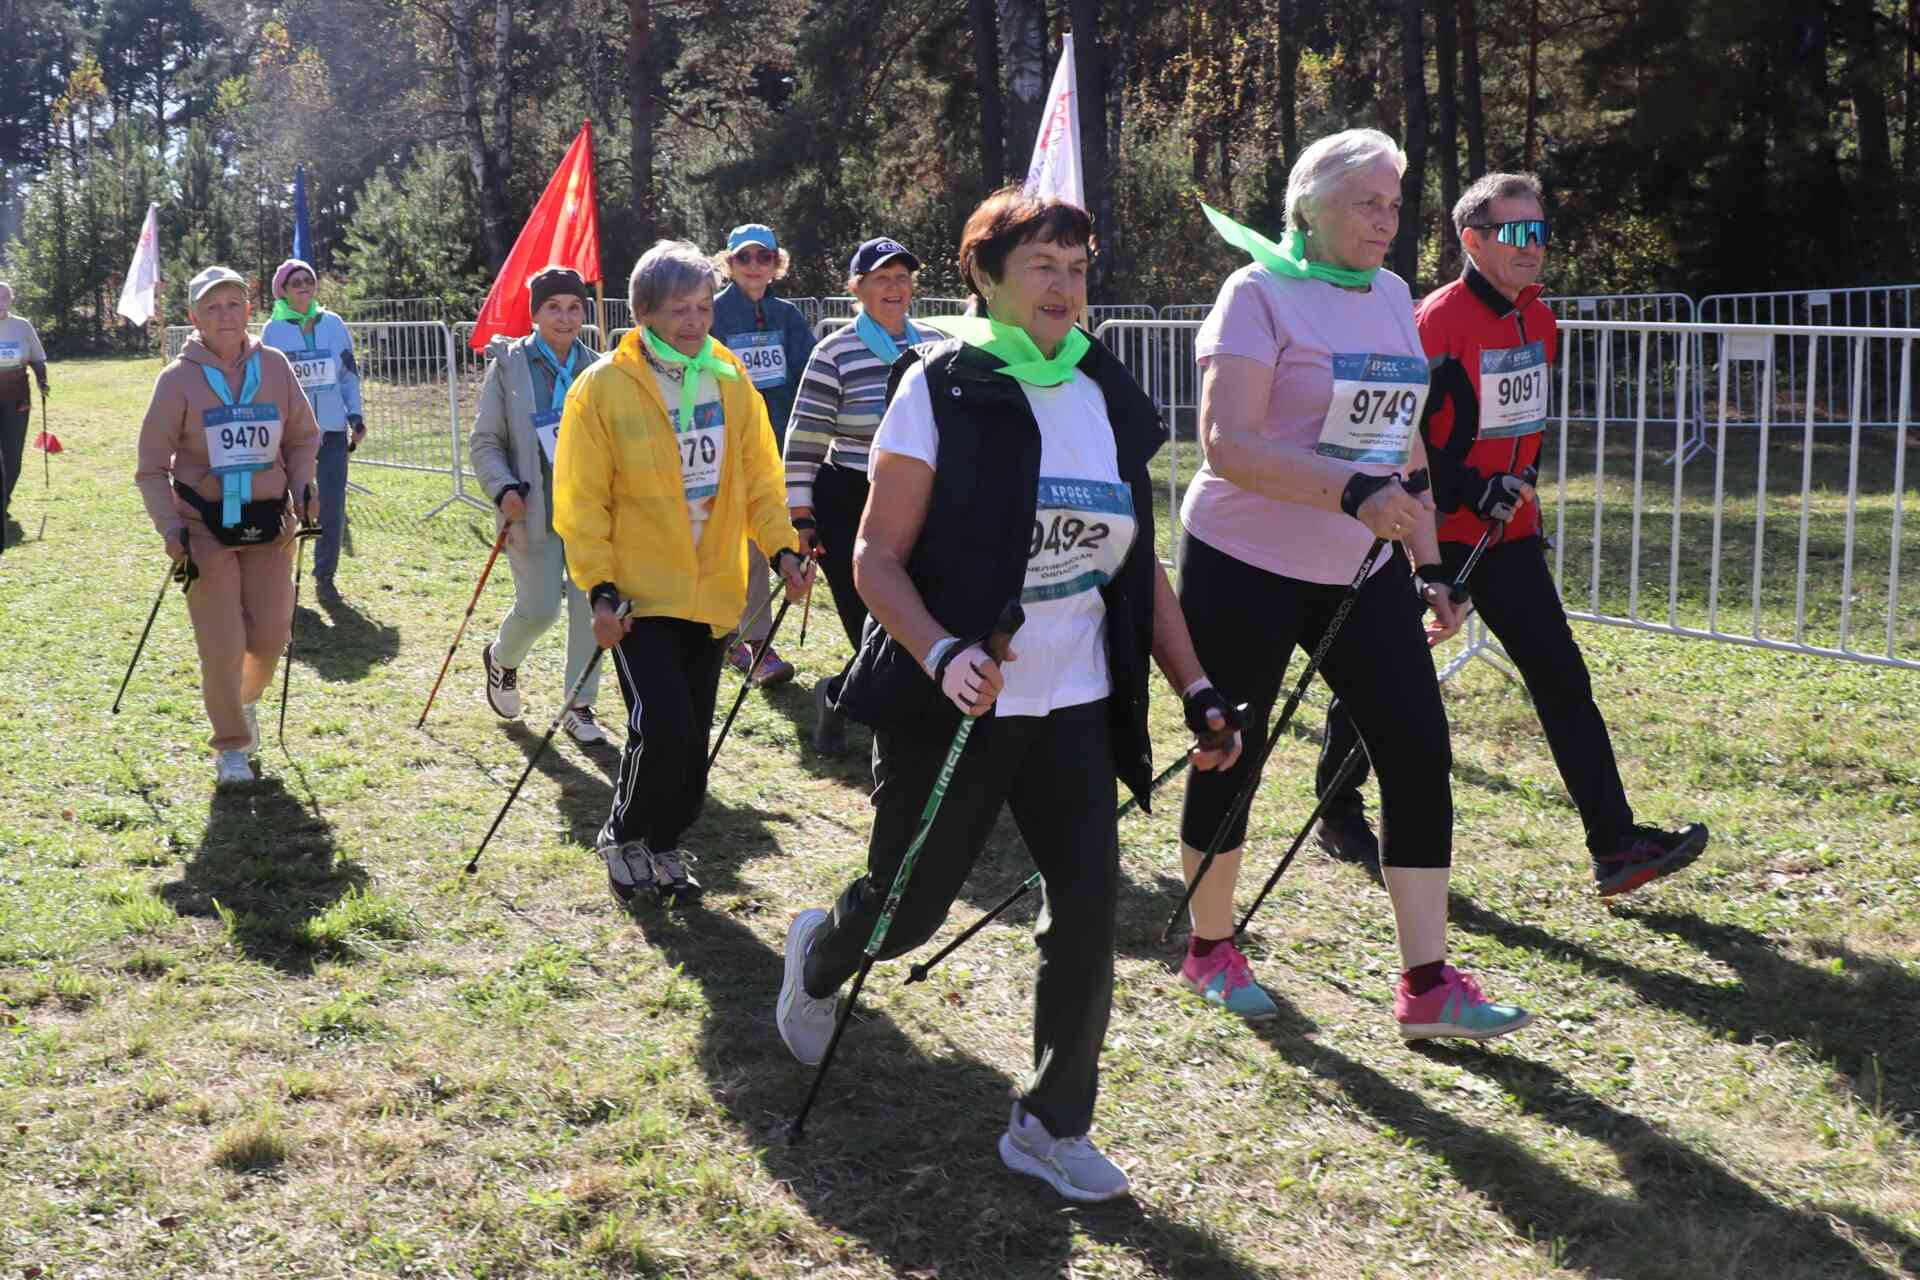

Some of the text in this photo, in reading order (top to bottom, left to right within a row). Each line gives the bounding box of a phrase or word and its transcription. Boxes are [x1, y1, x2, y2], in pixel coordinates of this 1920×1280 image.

[294, 361, 326, 378] 9017
[742, 349, 782, 370] 9486
[1498, 371, 1541, 406] 9097
[1349, 389, 1417, 426] 9749
[220, 425, 270, 450] 9470
[679, 435, 716, 468] 70
[1049, 485, 1091, 499] КРОСС
[1025, 515, 1110, 561] 9492
